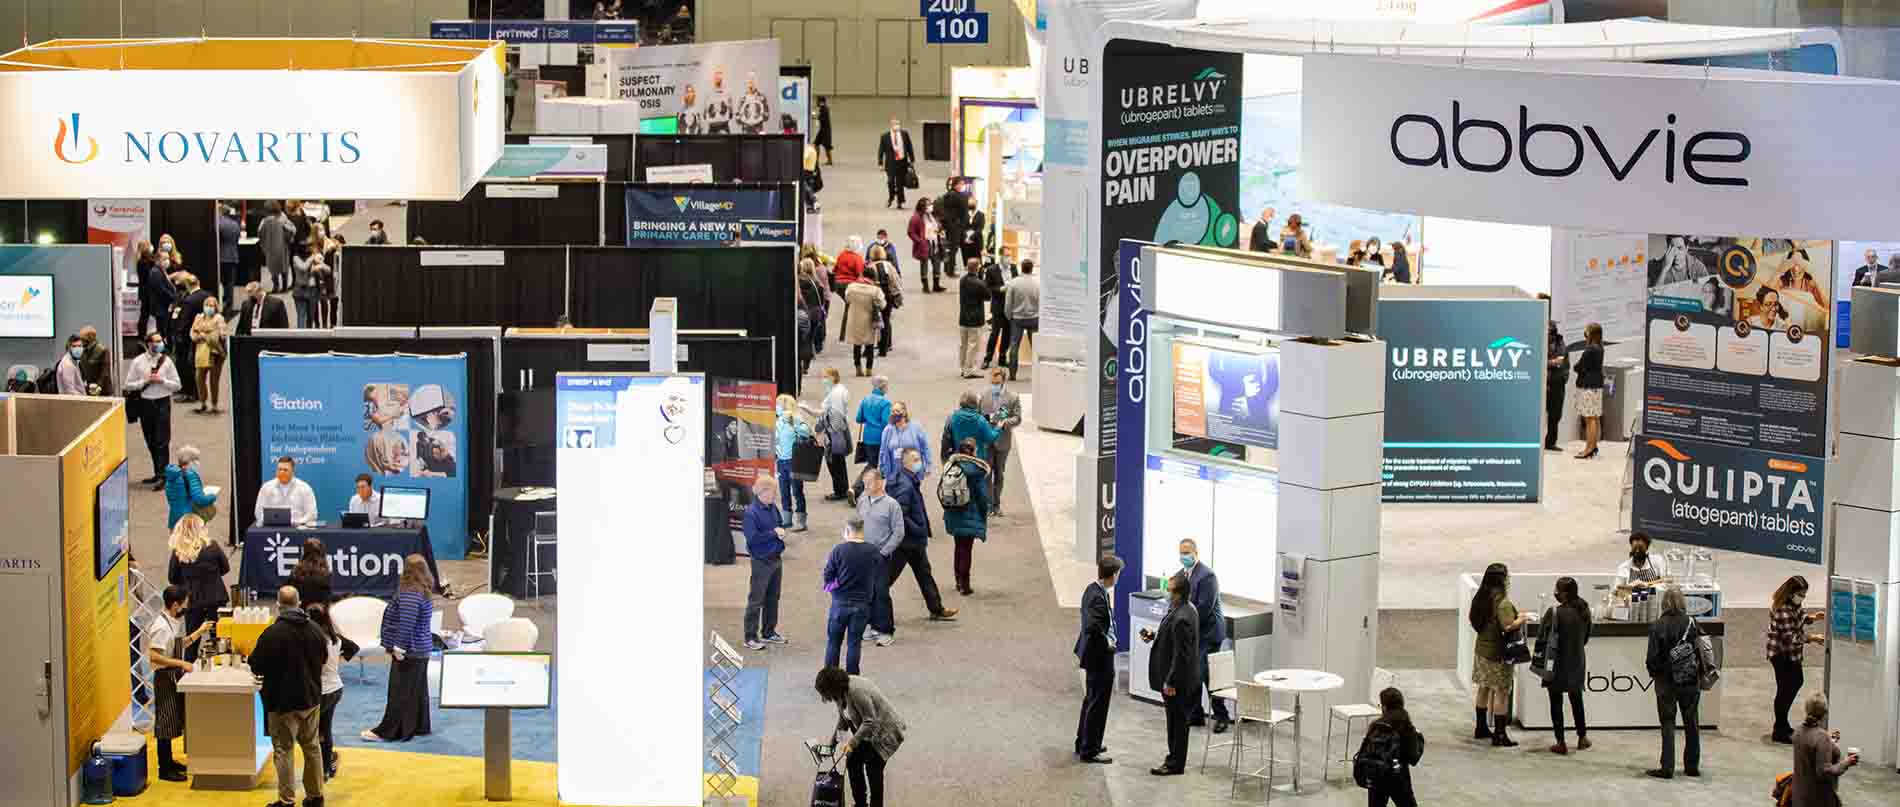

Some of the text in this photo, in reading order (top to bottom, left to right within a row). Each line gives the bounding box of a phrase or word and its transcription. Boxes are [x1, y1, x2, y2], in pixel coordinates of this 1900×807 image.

[936, 18, 979, 38] 100
[620, 75, 660, 87] SUSPECT
[620, 86, 675, 98] PULMONARY
[1120, 80, 1222, 108] UBRELVY
[639, 98, 661, 109] OSIS
[1120, 104, 1213, 125] (ubrogepant) tablets
[1229, 126, 1238, 134] TO
[123, 131, 361, 163] NOVARTIS
[1390, 100, 1751, 186] abbvie
[1105, 138, 1238, 177] OVERPOWER
[1105, 176, 1155, 206] PAIN
[633, 221, 686, 232] BRINGING
[688, 222, 697, 231] A
[700, 222, 726, 232] NEW
[633, 231, 680, 240] PRIMARY
[682, 232, 710, 240] CARE
[713, 232, 728, 240] TO
[1124, 257, 1144, 402] abbvie
[1392, 348, 1523, 368] UBRELVY
[1392, 368, 1513, 381] (ubrogepant) tablets
[274, 397, 322, 409] Elation
[1671, 498, 1759, 530] (atogepant)
[1760, 512, 1815, 537] tablets
[276, 545, 404, 577] Etion
[1584, 671, 1656, 692] bbv
